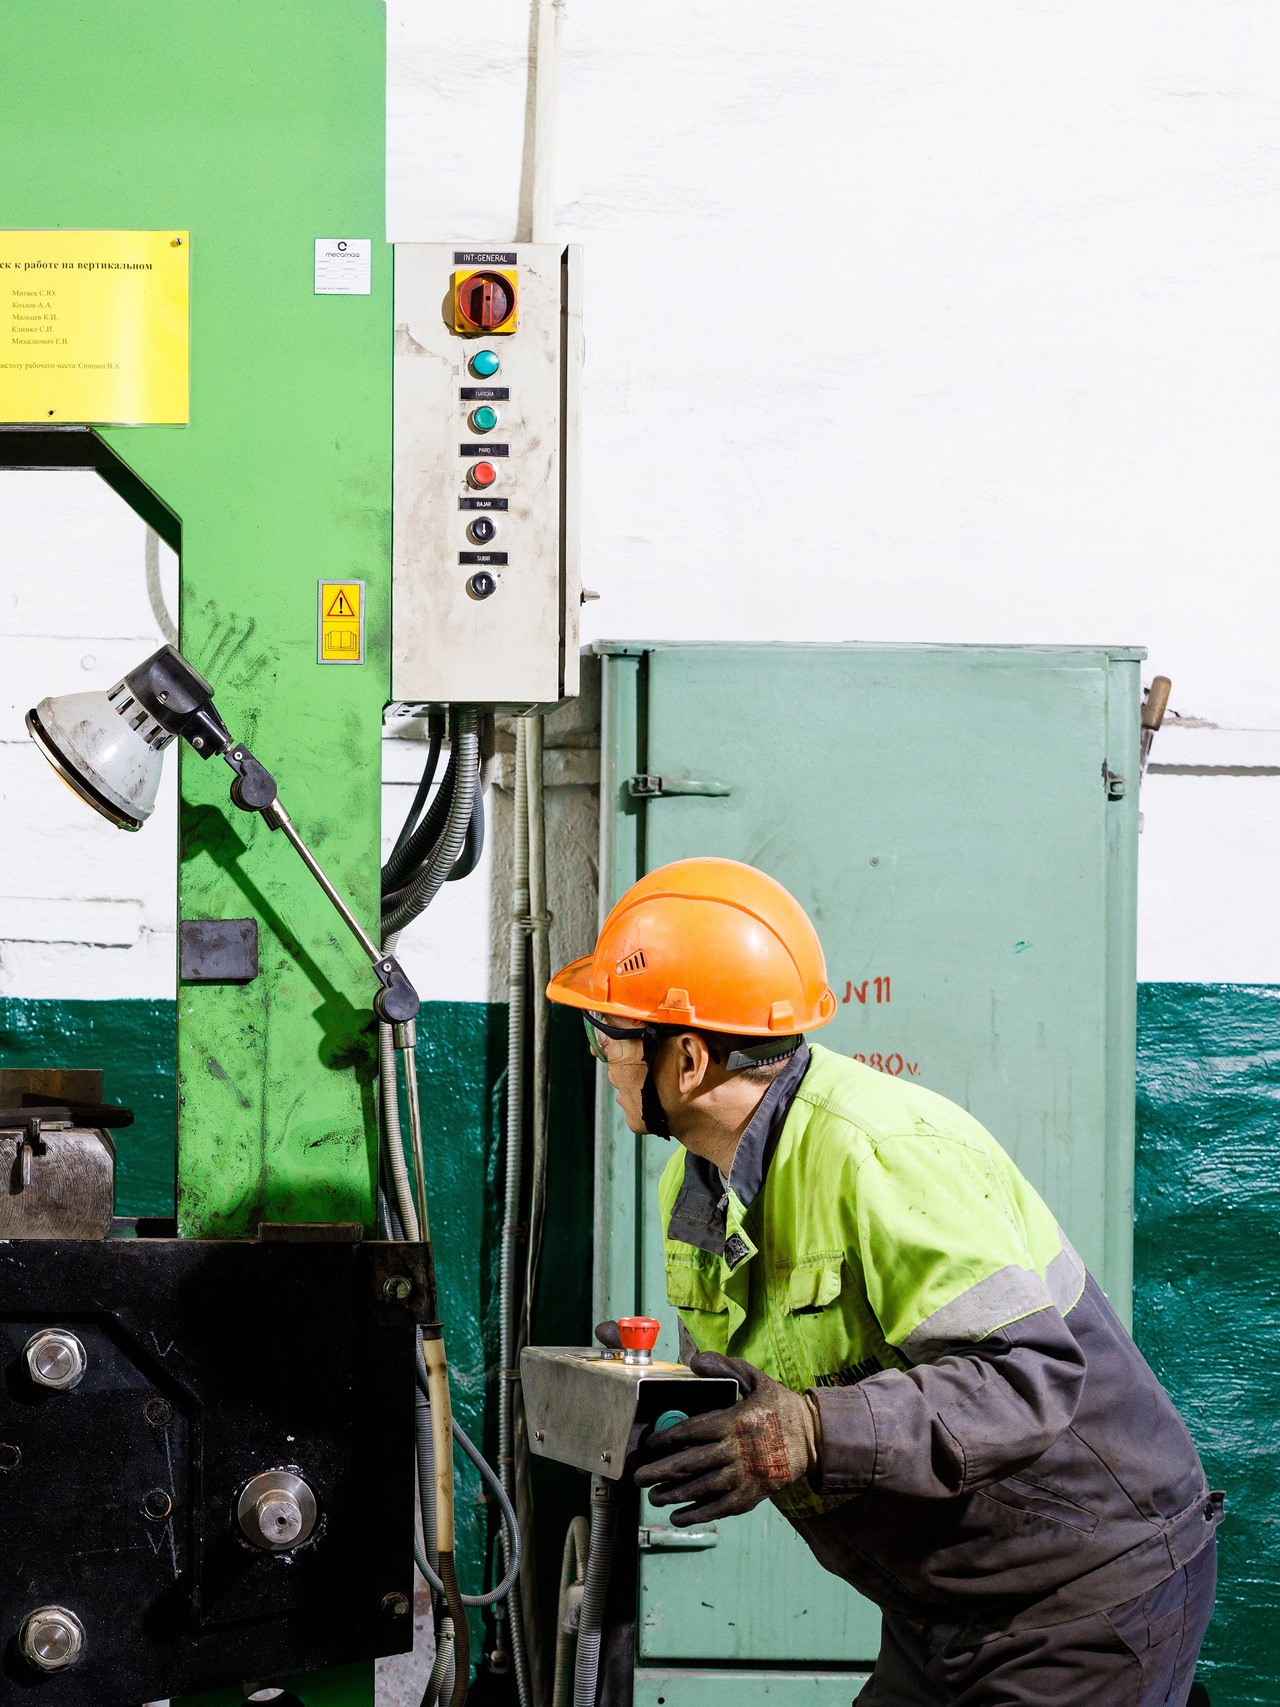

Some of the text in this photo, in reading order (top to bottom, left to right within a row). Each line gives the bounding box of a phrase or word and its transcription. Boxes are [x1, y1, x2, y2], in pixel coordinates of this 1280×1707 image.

[463, 254, 508, 262] INT-GENERAL
[24, 260, 59, 271] работе
[77, 262, 153, 271] вертикальном
[24, 362, 55, 370] рабочего
